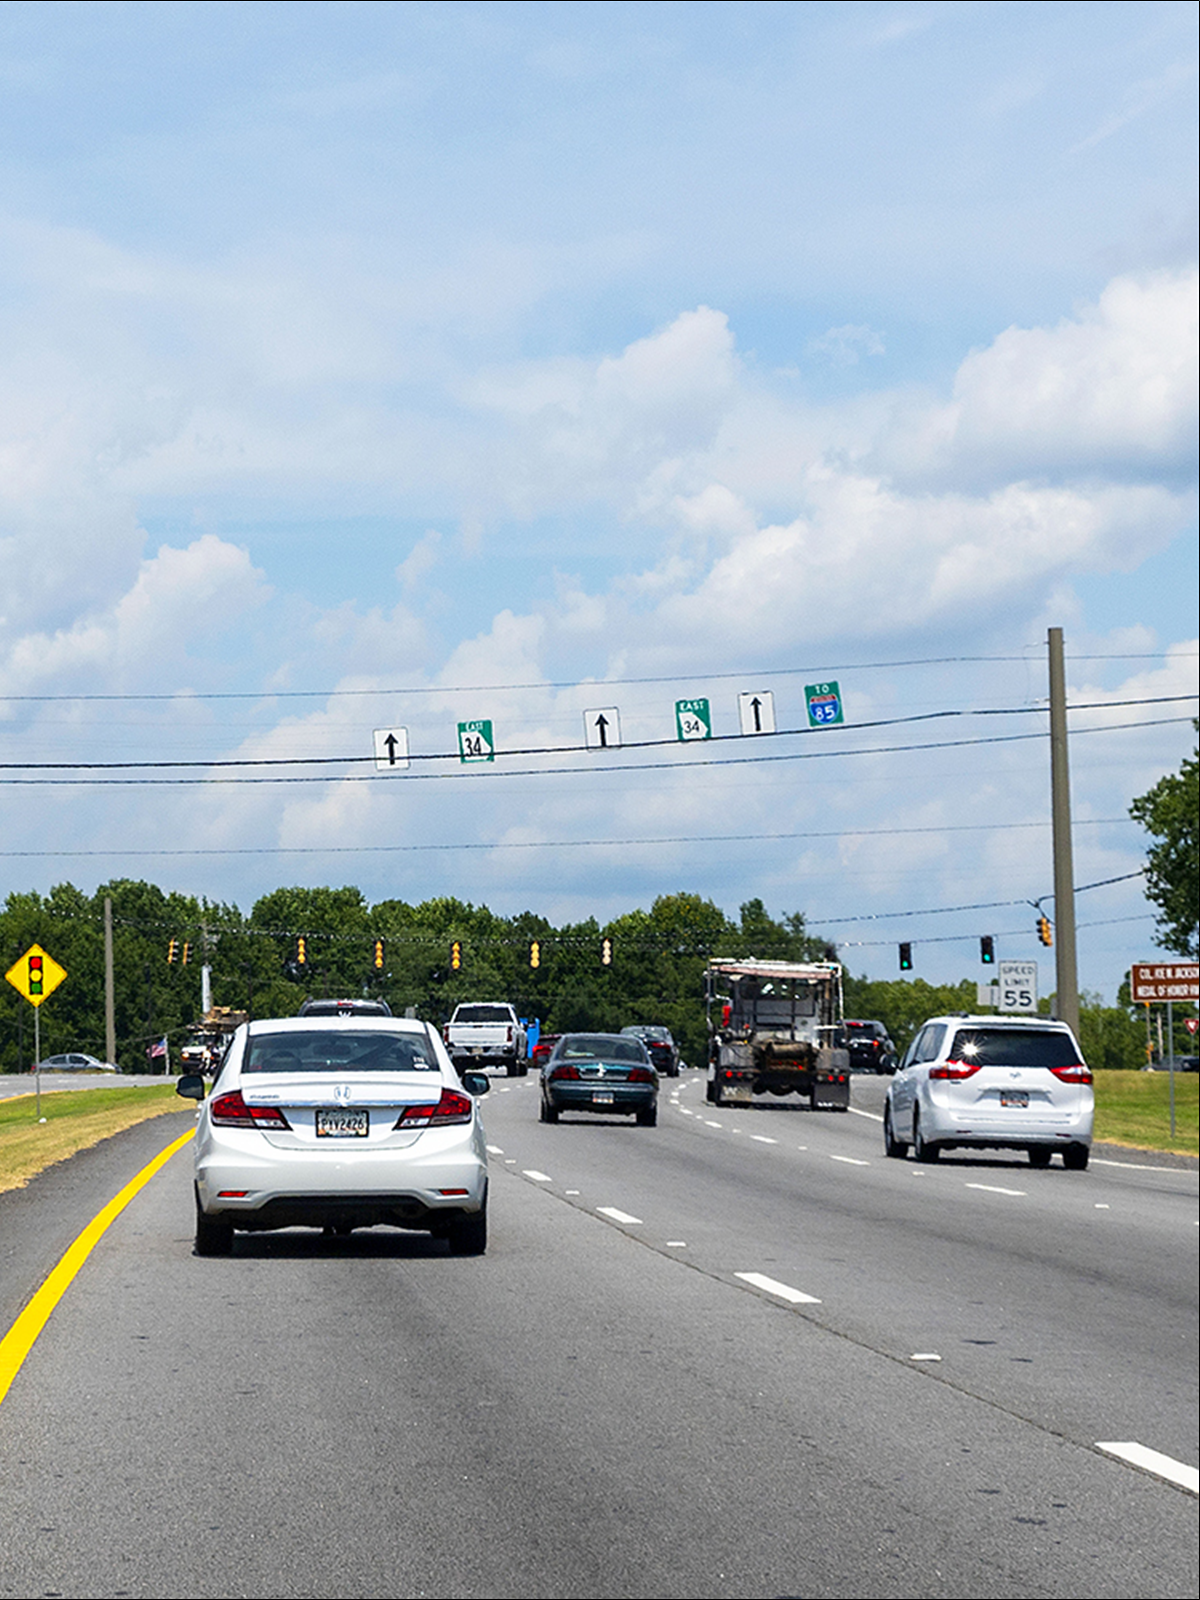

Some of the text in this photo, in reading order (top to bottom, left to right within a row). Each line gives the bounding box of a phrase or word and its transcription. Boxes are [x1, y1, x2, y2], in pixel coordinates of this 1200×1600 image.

[815, 684, 830, 694] TO
[680, 700, 706, 711] EAST
[815, 705, 836, 721] 85
[684, 720, 700, 734] 34
[465, 736, 482, 757] 34
[1002, 966, 1035, 975] SPEED
[1004, 978, 1030, 987] LIMIT
[1005, 990, 1033, 1007] 55
